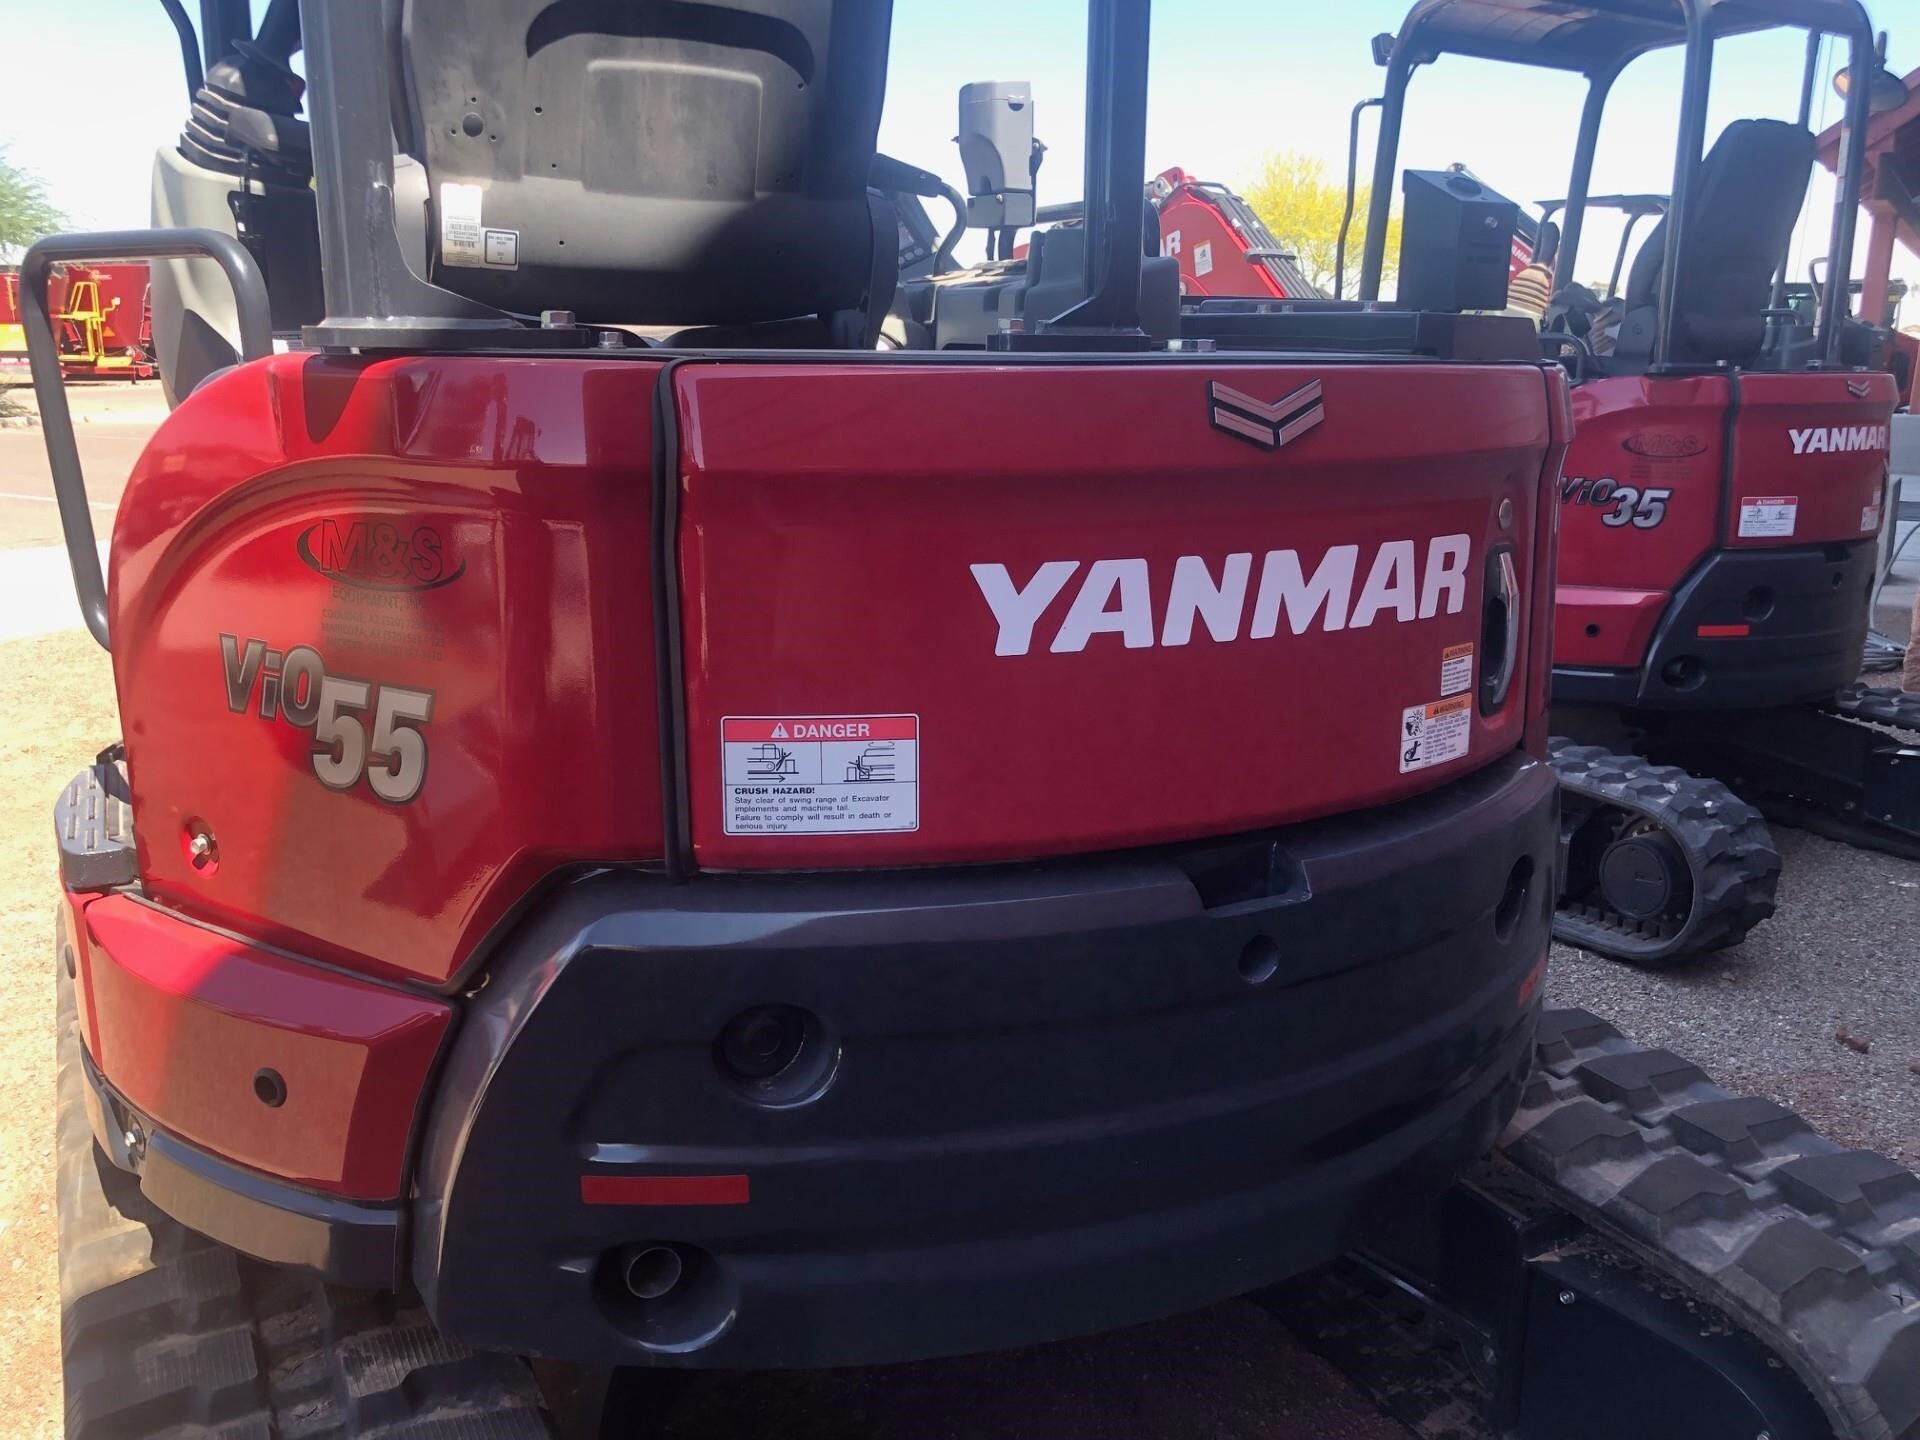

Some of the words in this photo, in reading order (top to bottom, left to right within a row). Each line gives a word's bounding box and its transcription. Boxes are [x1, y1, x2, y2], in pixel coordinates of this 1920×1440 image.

[1788, 426, 1886, 454] YANMAR
[319, 517, 443, 582] M&S
[969, 533, 1471, 656] YANMAR
[793, 723, 870, 738] DANGER
[734, 787, 769, 795] CRUSH
[772, 787, 815, 795] HAZARD!
[734, 796, 751, 805] Stay
[755, 796, 774, 804] clear
[777, 796, 786, 804] of
[789, 796, 811, 805] swing
[815, 797, 837, 805] range
[841, 795, 848, 803] of
[852, 794, 889, 802] Excavator
[734, 805, 779, 814] implements
[801, 804, 832, 812] machine
[776, 813, 804, 823] comply
[807, 813, 820, 821] will
